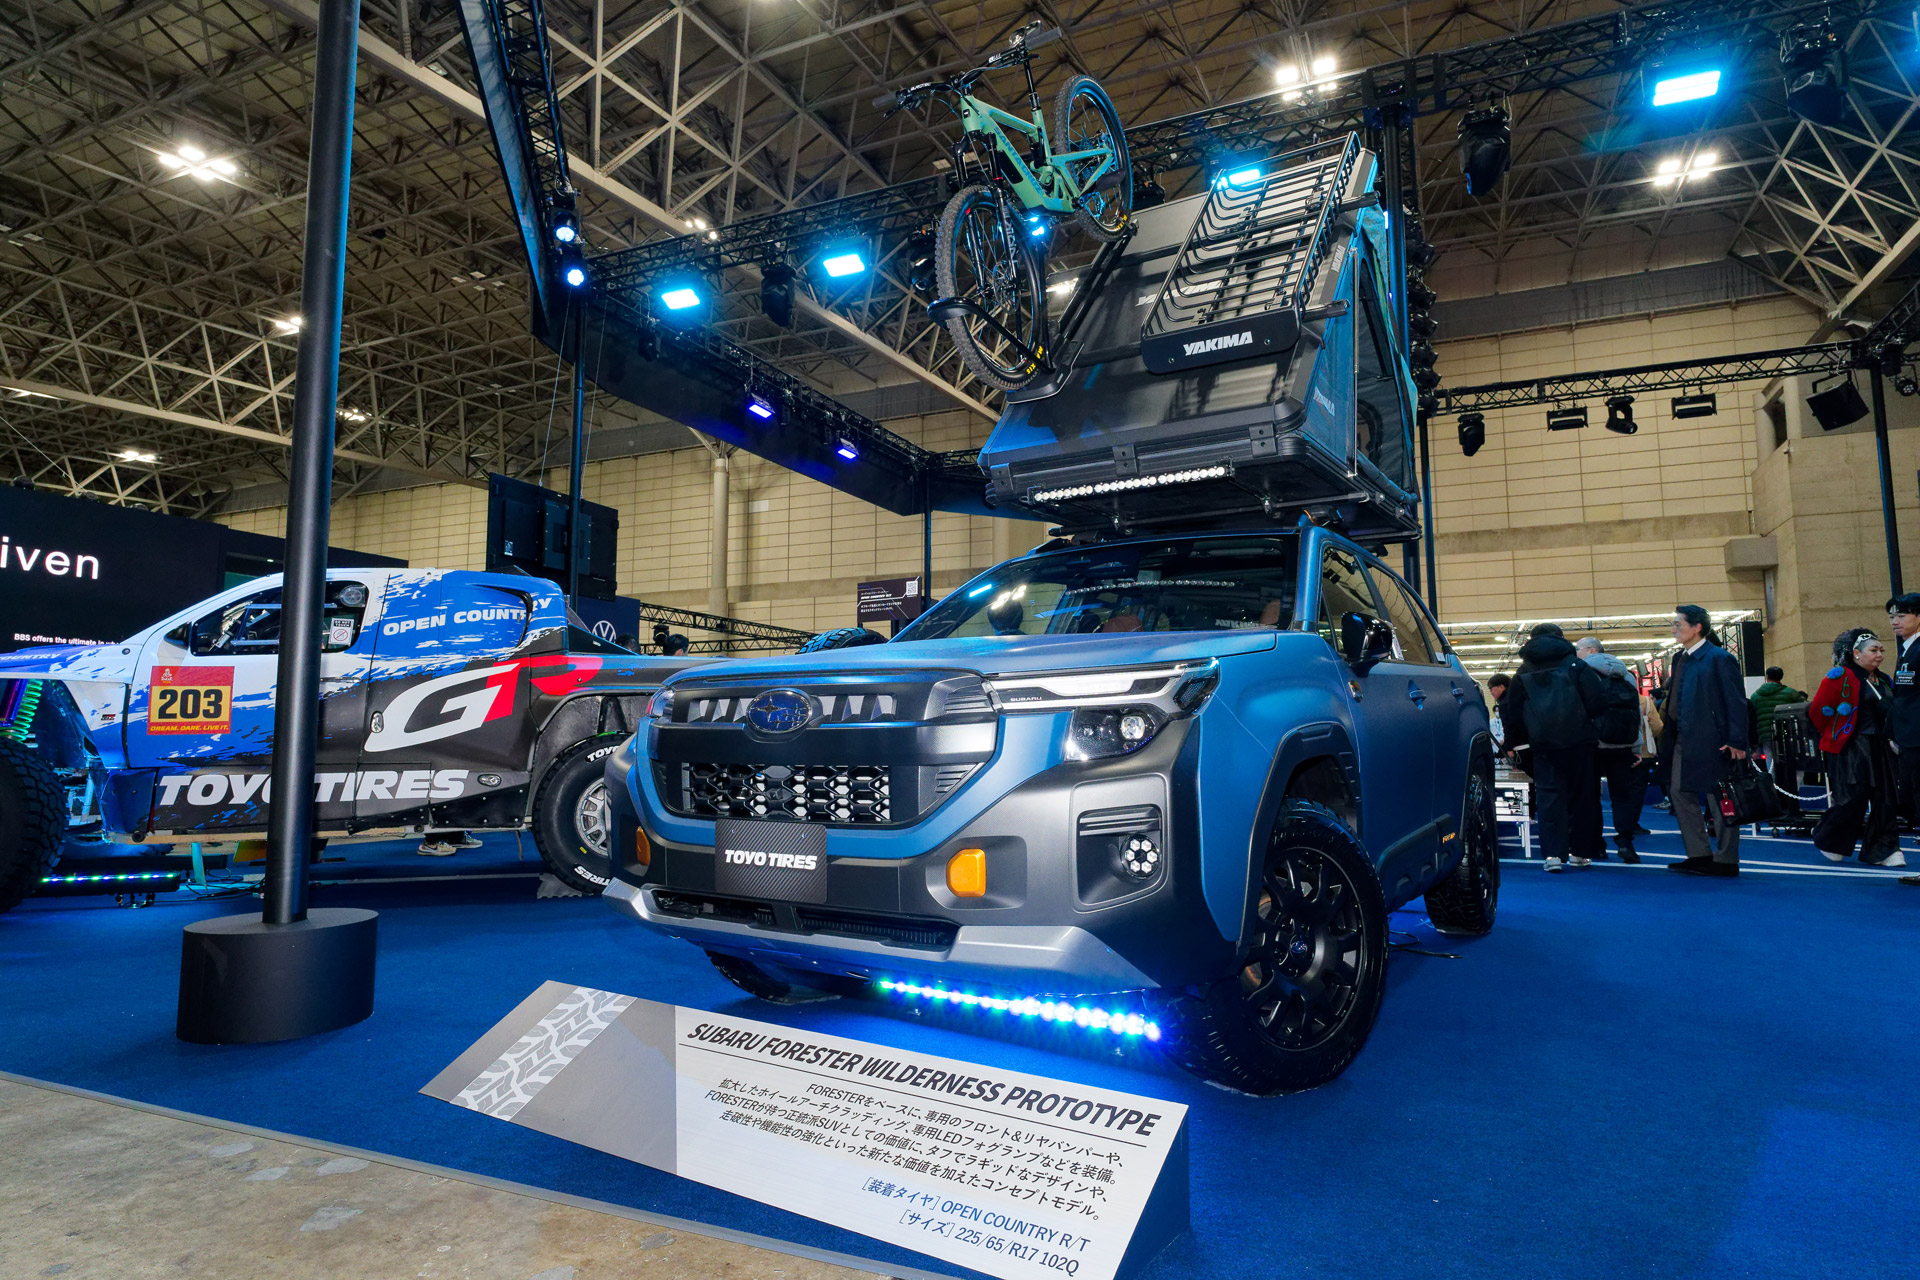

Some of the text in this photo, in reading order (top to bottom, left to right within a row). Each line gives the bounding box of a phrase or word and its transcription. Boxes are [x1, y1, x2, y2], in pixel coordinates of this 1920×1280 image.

[1183, 331, 1254, 356] YAKIMA
[14, 633, 31, 641] BBS
[31, 635, 54, 643] offers
[383, 614, 447, 636] OPEN
[158, 689, 223, 719] 203
[159, 770, 469, 805] TOY TIRES
[725, 849, 818, 870] TOYO TIRES
[574, 865, 610, 886] TIRES
[687, 1022, 1162, 1137] SUBARU FORESTER WILDERNESS PROTOTYPE
[940, 1200, 984, 1222] OPEN
[983, 1212, 1060, 1244] COUNTRY
[1058, 1232, 1092, 1252] R/T
[954, 1227, 1040, 1262] 225/65/R17
[1038, 1251, 1081, 1278] 102Q
